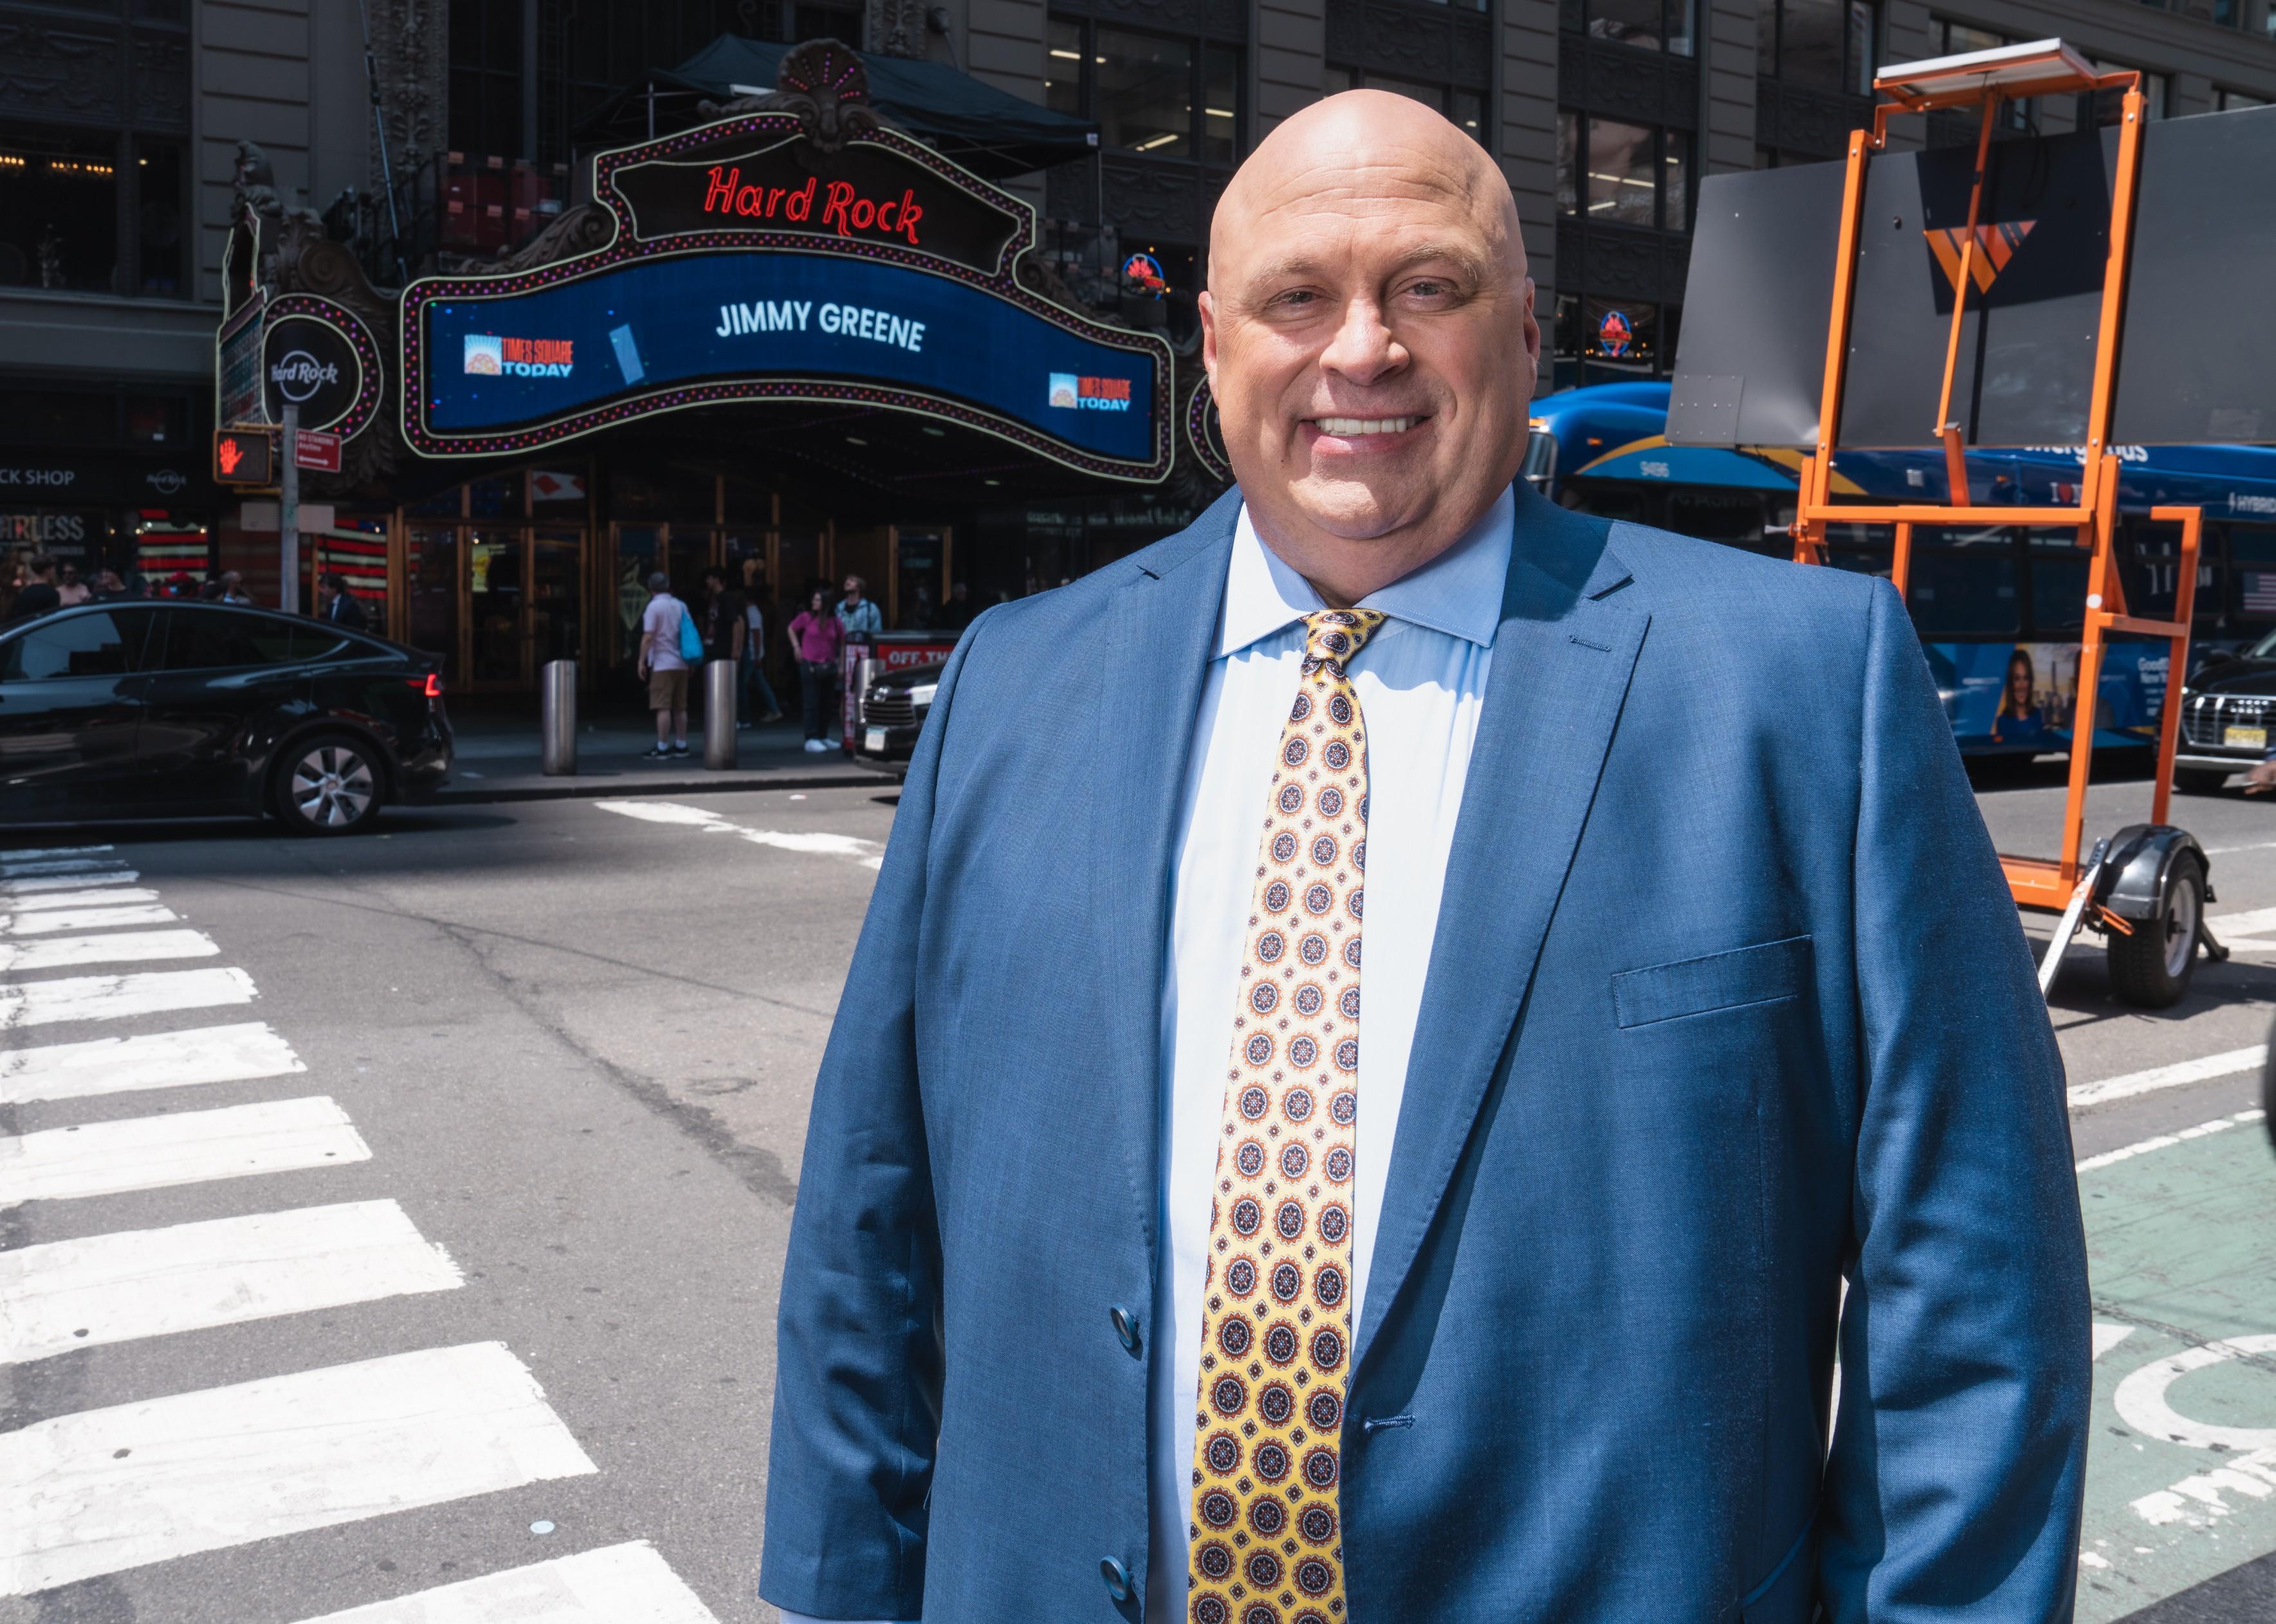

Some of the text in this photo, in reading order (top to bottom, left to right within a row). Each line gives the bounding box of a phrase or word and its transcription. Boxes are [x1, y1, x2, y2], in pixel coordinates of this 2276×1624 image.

[704, 166, 923, 245] Hard Rock
[716, 300, 926, 352] JIMMY GREENE
[502, 337, 573, 365] TIMES SQUARE
[271, 361, 338, 385] Hard Rock
[502, 361, 574, 378] TODAY
[1078, 397, 1131, 412] TODAY
[25, 469, 76, 486] SHOP
